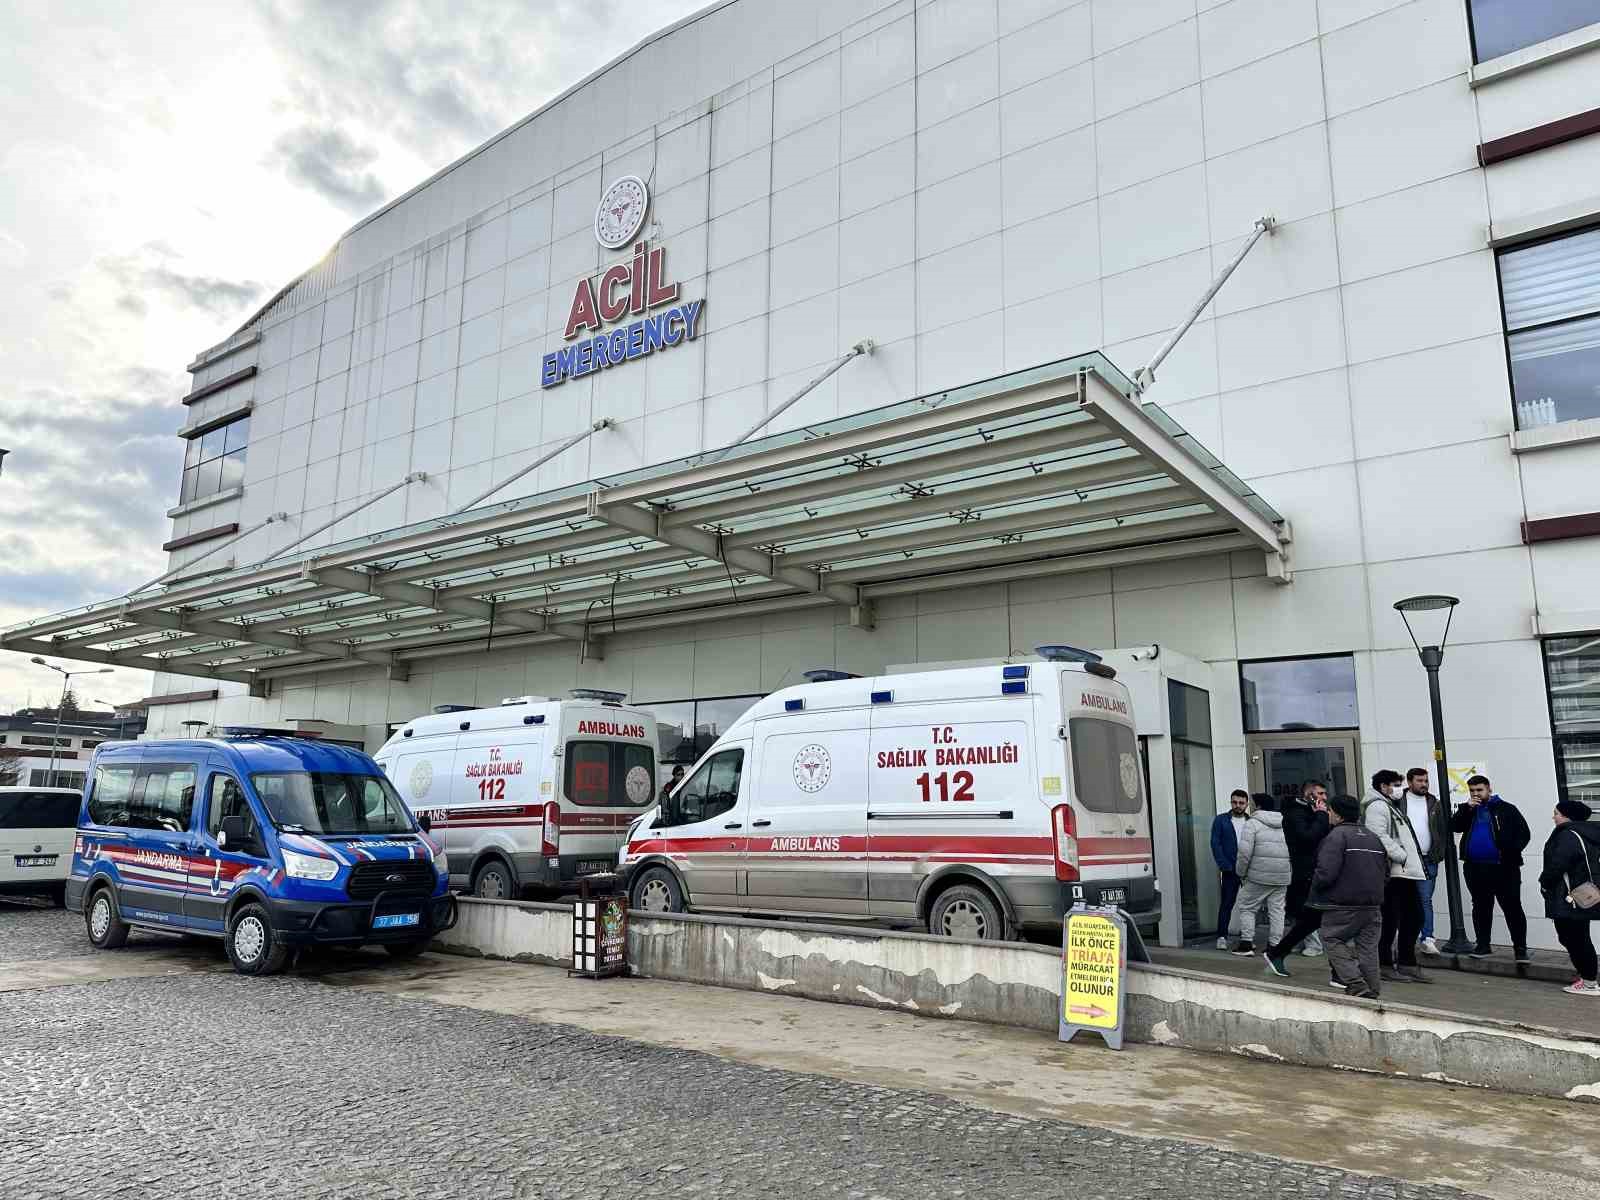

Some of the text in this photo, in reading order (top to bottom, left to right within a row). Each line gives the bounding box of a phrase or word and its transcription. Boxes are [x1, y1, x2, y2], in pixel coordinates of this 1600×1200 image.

[562, 240, 681, 341] ACİL
[540, 298, 705, 389] EMERGENCY
[1081, 692, 1127, 715] AMBULANS
[578, 720, 645, 738] AMBULANS
[932, 726, 958, 744] T.C.
[490, 748, 502, 761] T.C.
[877, 741, 1018, 768] SAĞLIK BAKANLIĞI
[465, 759, 523, 777] SAĞLIK BAKANLIĞI
[478, 778, 505, 800] 112
[916, 770, 975, 802] 112
[770, 837, 840, 851] AMBULANS
[134, 849, 182, 871] JANDARMA
[1071, 935, 1115, 950] İLK ÖNCE
[1071, 962, 1114, 974] MÜRACAAT
[1070, 982, 1114, 997] OLUNUR
